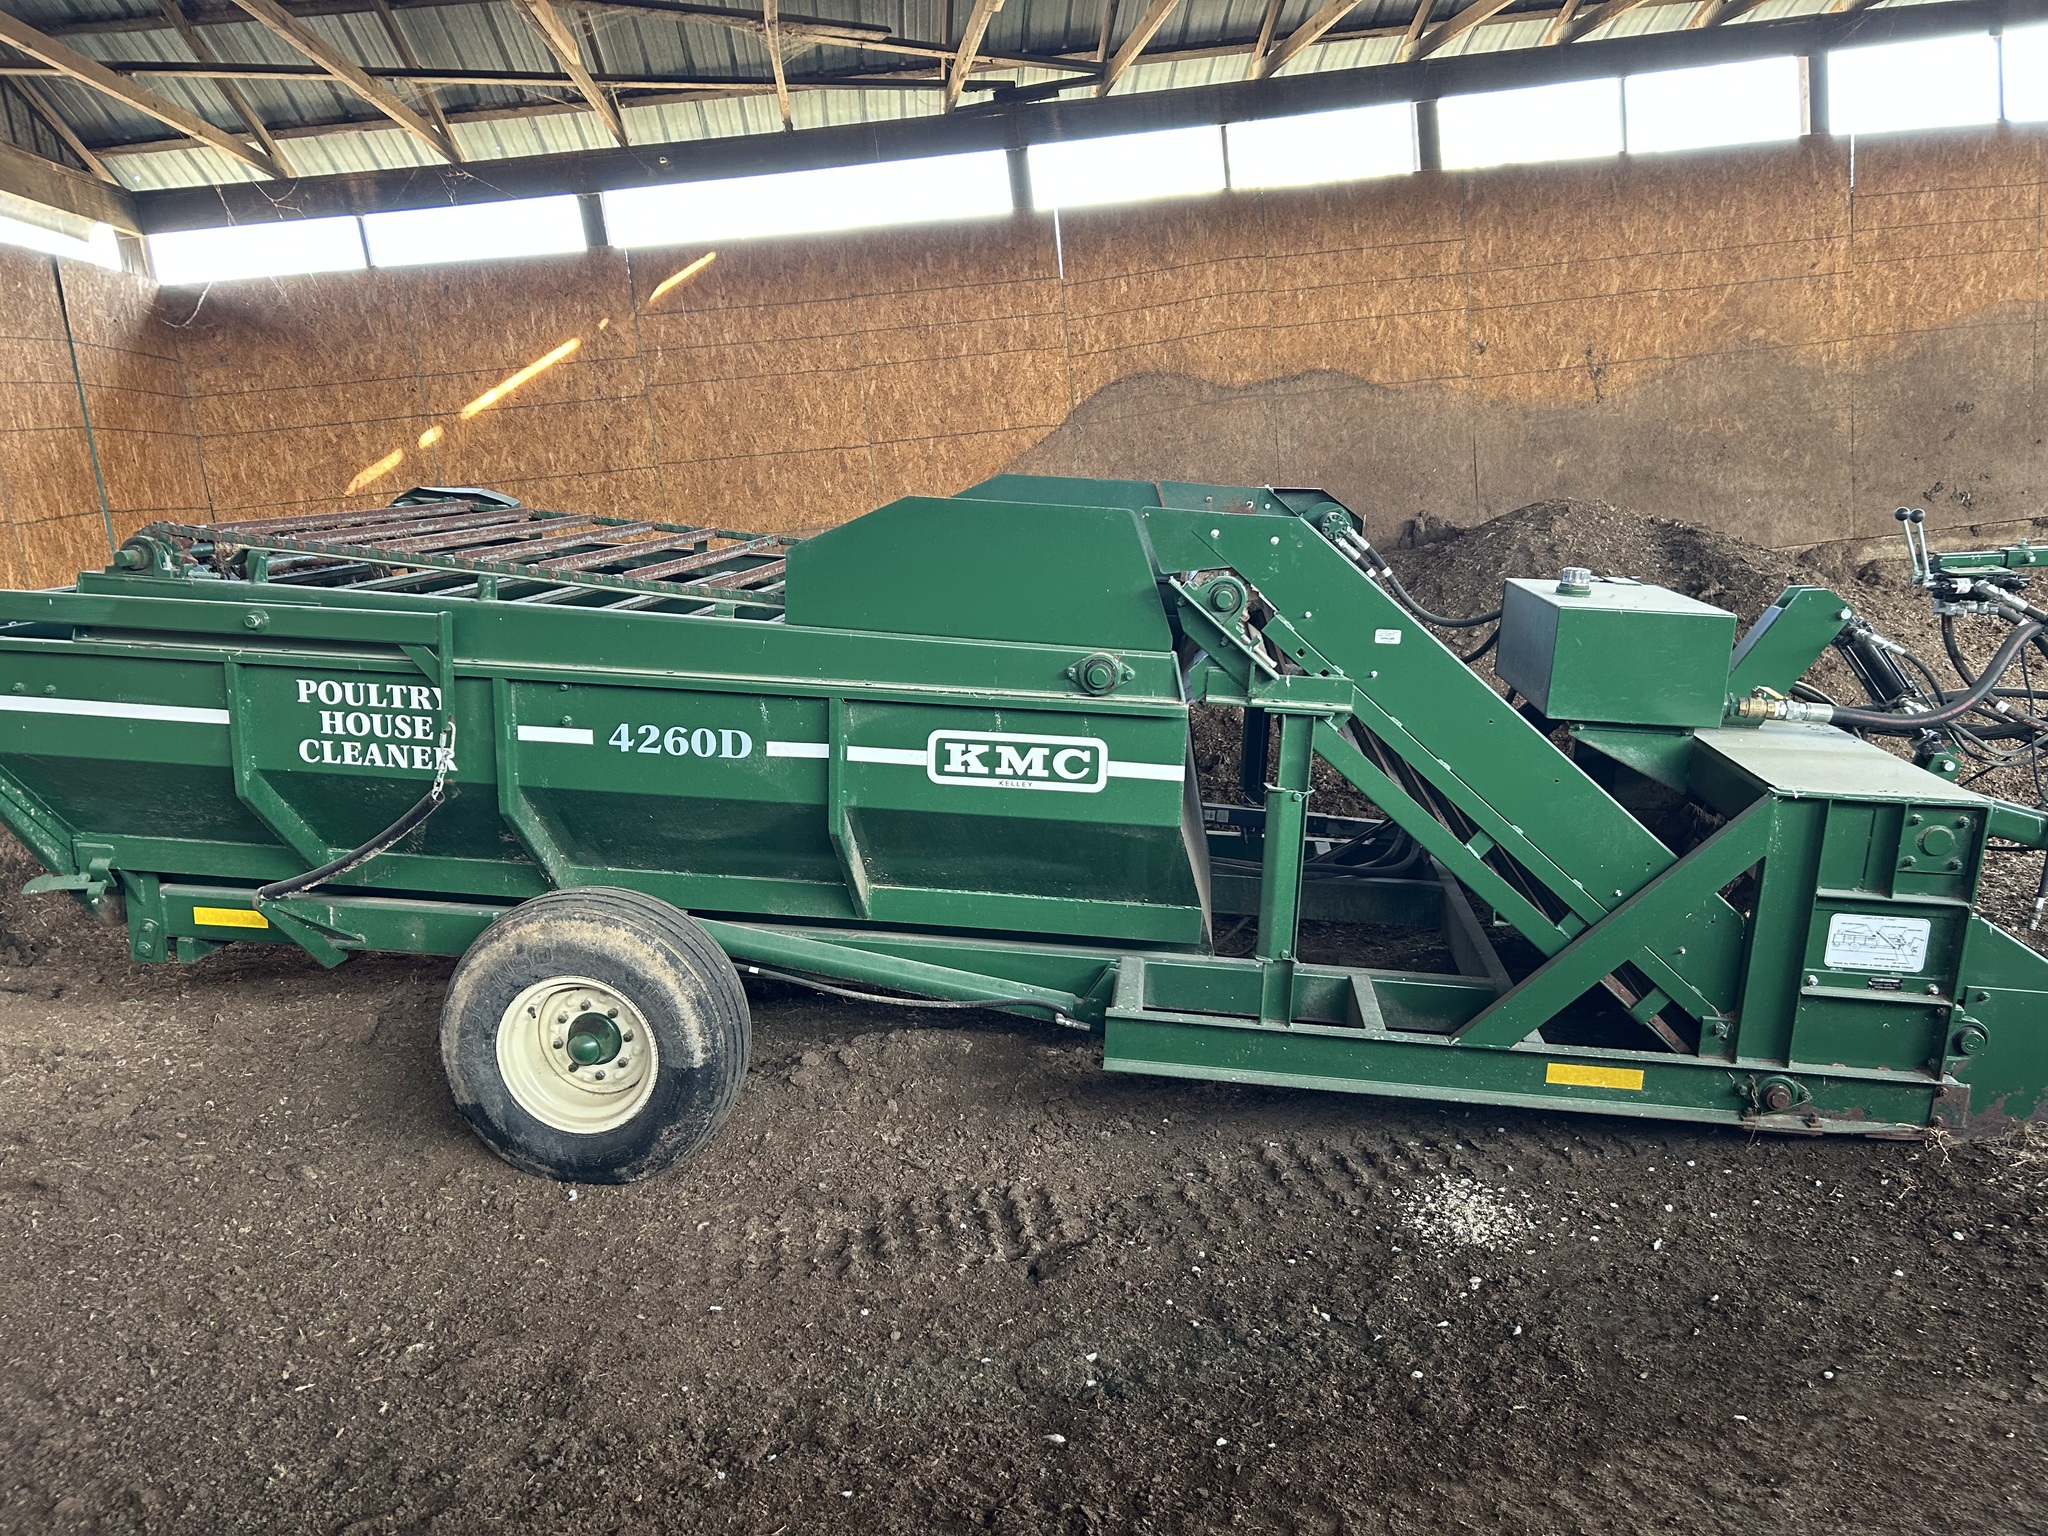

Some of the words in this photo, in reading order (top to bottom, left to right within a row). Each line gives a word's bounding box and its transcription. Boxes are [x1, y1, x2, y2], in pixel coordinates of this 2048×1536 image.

[319, 710, 433, 740] HOUSE
[608, 723, 753, 759] 4260D
[299, 738, 458, 771] CLEANER
[943, 742, 1091, 780] KMC
[998, 780, 1033, 788] KELLEY
